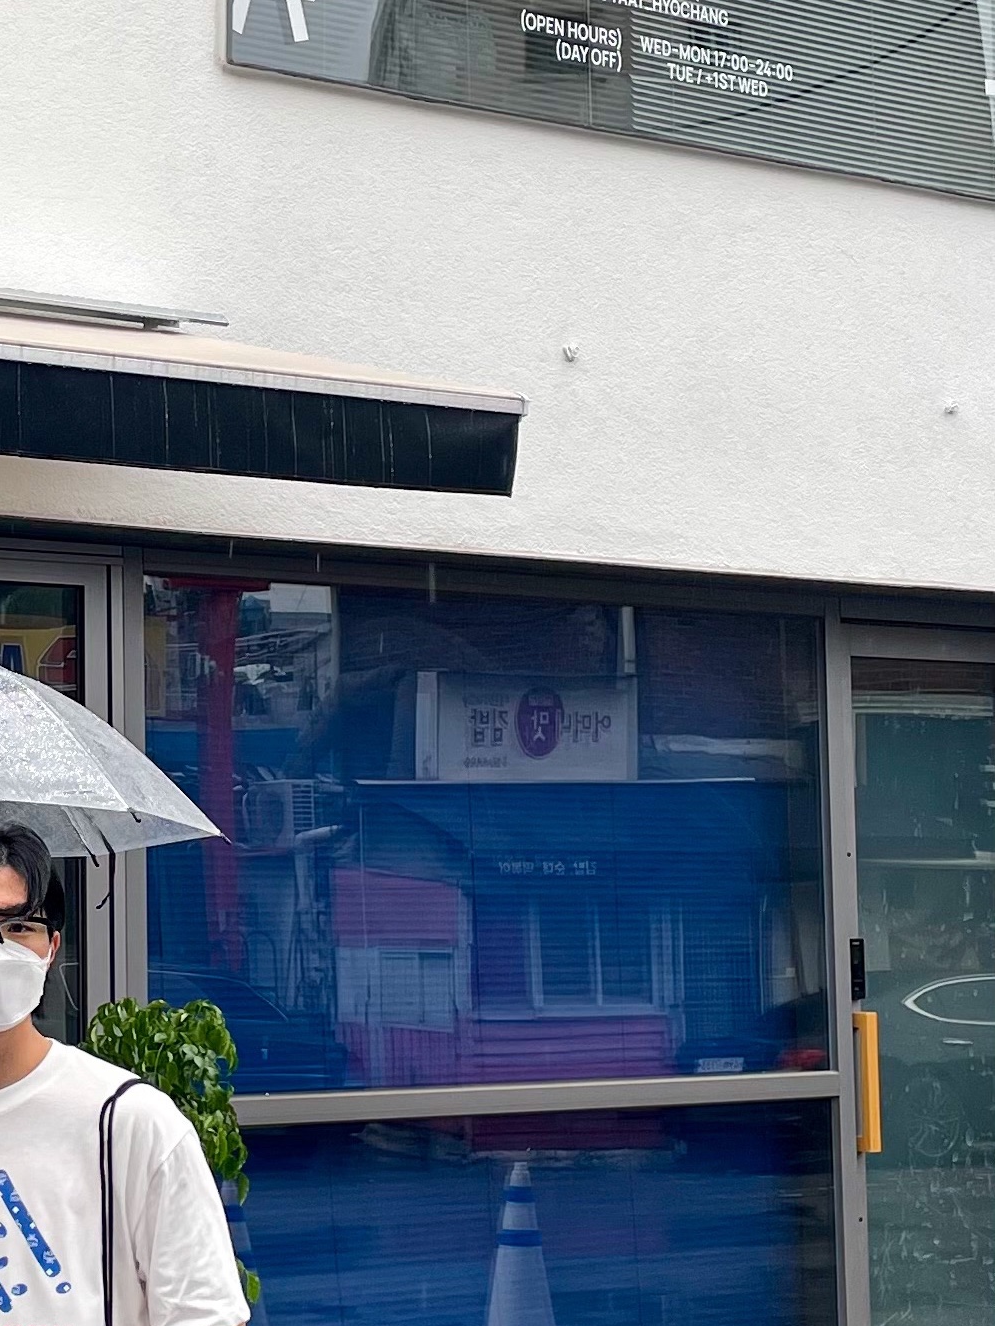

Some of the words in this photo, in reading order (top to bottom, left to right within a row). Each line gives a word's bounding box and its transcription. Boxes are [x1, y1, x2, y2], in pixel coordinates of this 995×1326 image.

[520, 8, 565, 37] (OPEN
[567, 20, 622, 49] HOURS)
[556, 38, 590, 63] (DAY
[591, 48, 622, 72] OFF)
[639, 35, 711, 65] WED-MON
[712, 49, 794, 81] 17:00-24:00
[667, 62, 694, 84] TUE
[738, 78, 769, 97] WED
